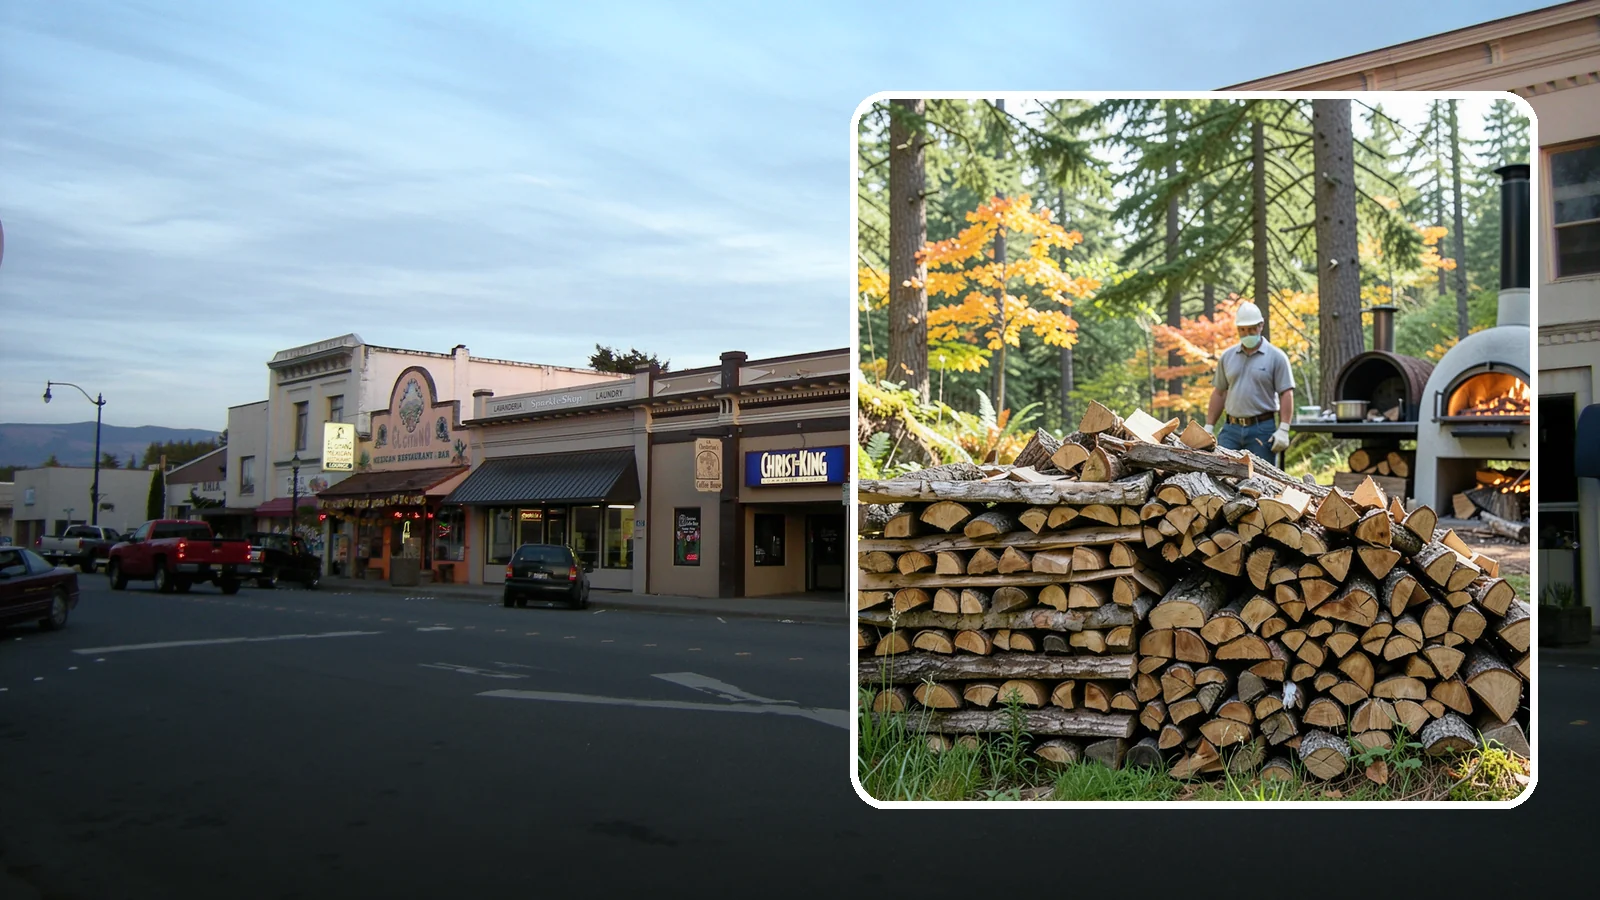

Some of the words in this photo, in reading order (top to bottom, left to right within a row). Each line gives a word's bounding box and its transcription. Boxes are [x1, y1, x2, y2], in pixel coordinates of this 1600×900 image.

[561, 394, 582, 405] Shop
[596, 389, 624, 400] LAUNDRY
[494, 402, 523, 413] LAVANDERIA
[391, 425, 402, 450] EL
[402, 420, 431, 449] GITANO
[327, 449, 352, 457] MEXICAN
[373, 455, 397, 465] MEXICAN
[396, 452, 434, 463] RESTAURANT
[437, 450, 451, 460] BAR
[798, 450, 828, 477] KING
[696, 480, 709, 489] Coffee
[709, 480, 722, 489] House
